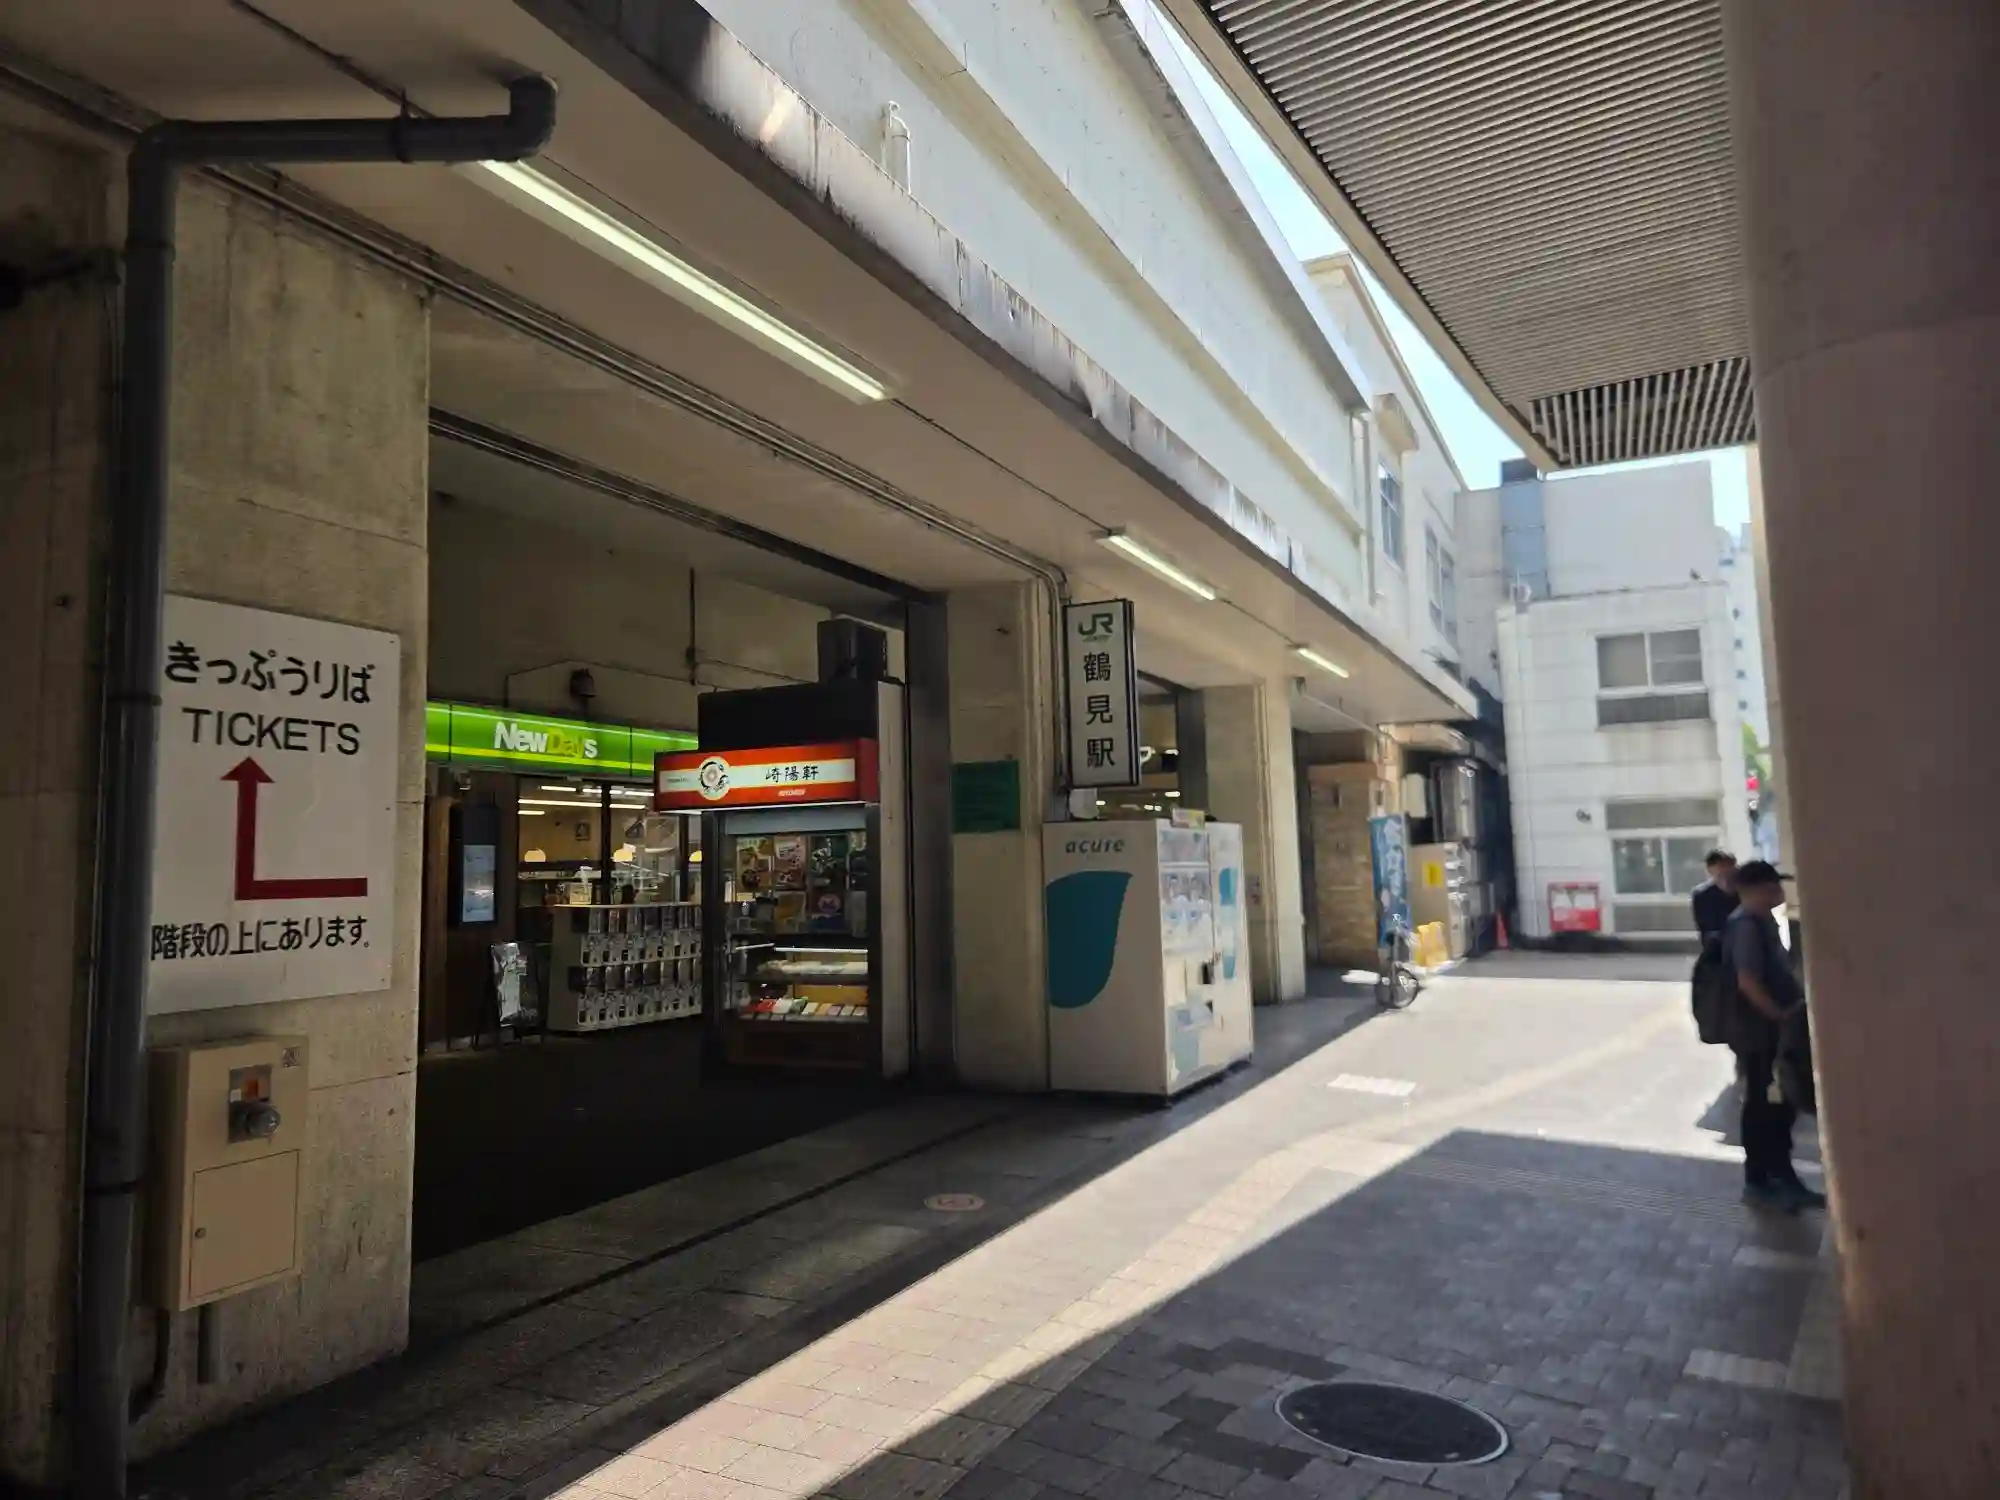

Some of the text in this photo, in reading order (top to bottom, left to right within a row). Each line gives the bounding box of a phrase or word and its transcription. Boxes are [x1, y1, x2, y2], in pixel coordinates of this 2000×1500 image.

[1078, 613, 1114, 635] JR
[165, 640, 375, 704] きっぷうりば
[1083, 652, 1115, 768] 鶴見駅
[182, 707, 360, 755] TICKETS
[494, 722, 598, 759] NewDays
[765, 764, 819, 783] 崎陽軒
[1065, 837, 1125, 854] acure
[151, 915, 370, 961] 階段の上にあります。
